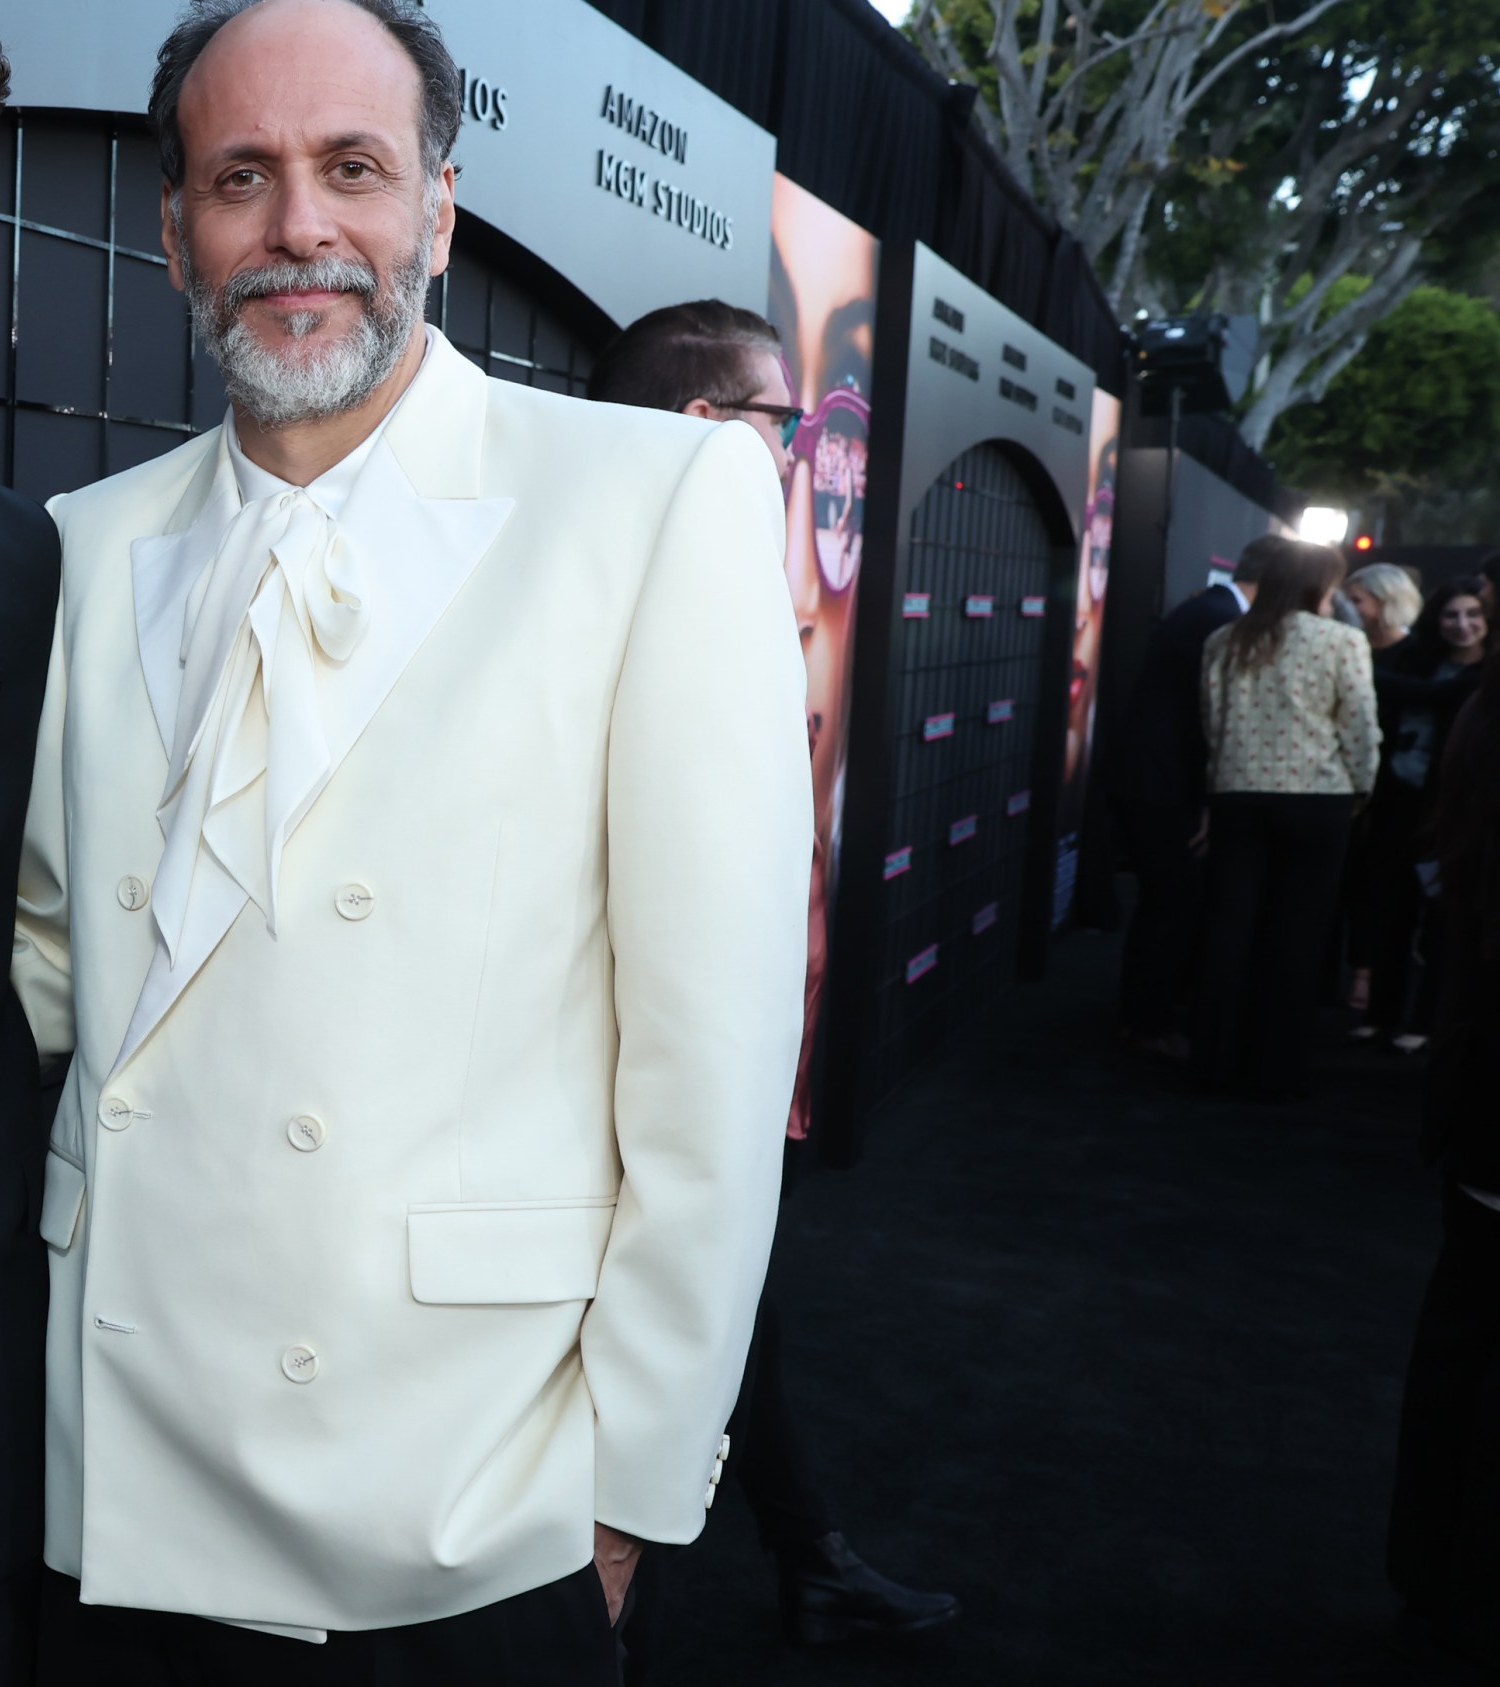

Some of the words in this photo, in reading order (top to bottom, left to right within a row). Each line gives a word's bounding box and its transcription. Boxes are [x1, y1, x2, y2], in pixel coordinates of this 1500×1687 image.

[600, 84, 688, 165] AMAZON
[596, 148, 649, 208] MGM
[652, 178, 734, 251] STUDIOS
